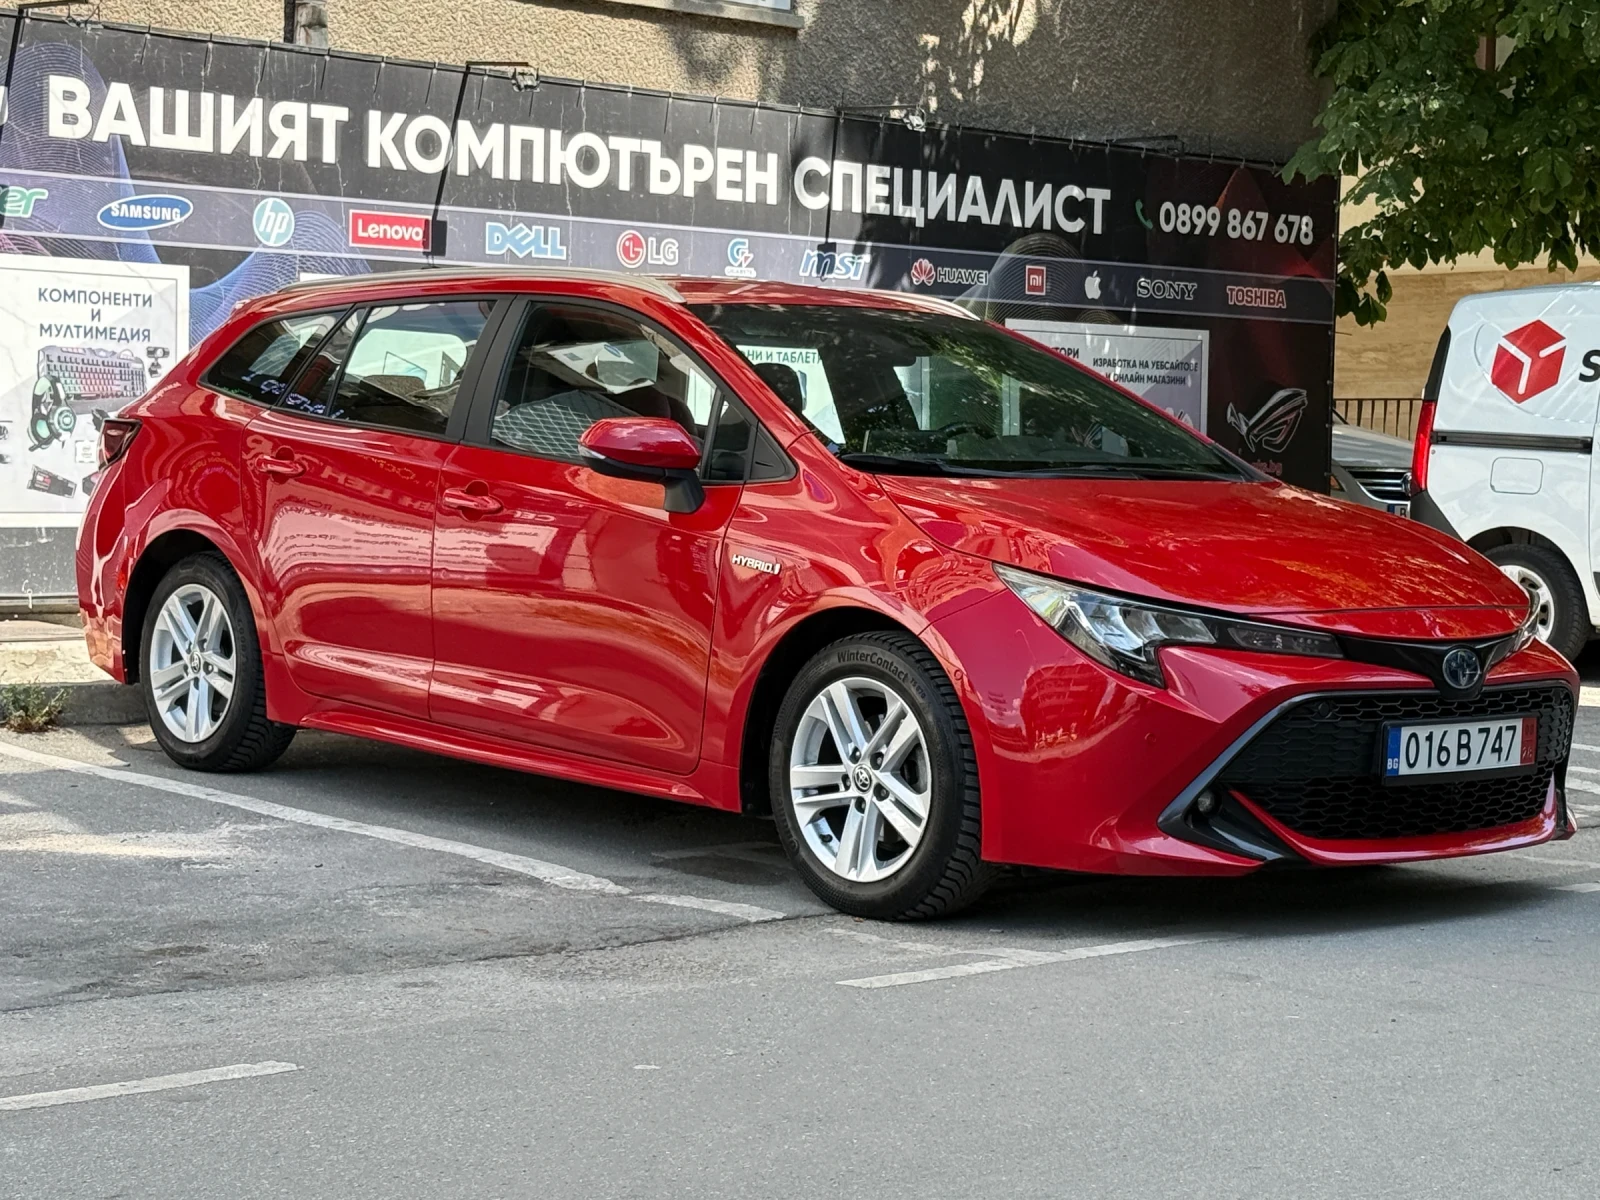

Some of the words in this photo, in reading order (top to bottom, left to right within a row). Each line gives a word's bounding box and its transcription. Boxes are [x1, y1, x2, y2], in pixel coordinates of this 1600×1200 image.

[48, 75, 349, 164] ВАШИЯТ
[368, 110, 778, 205] КОМПЮТЪРЕН
[794, 156, 1111, 235] СПЕЦИАЛИСТ
[110, 202, 181, 222] SAMSUNG
[261, 200, 287, 245] hp
[357, 219, 424, 241] Lenovo
[1159, 201, 1221, 236] 0899
[1227, 208, 1269, 241] 867
[1274, 214, 1313, 245] 678
[486, 222, 567, 260] DELL
[648, 237, 679, 265] LG
[800, 249, 867, 280] msi
[937, 267, 989, 286] HUAWEI
[38, 287, 152, 308] КОМПОНЕНТИ
[1136, 278, 1197, 300] SONY
[1226, 285, 1287, 308] TOSHIBA
[91, 308, 101, 323] И
[39, 323, 151, 343] МУЛТИМЕДИЯ
[741, 349, 763, 361] НИ
[776, 351, 821, 364] ТАБЛЕТ
[1093, 357, 1137, 369] ИЗРАБОТКА
[1139, 359, 1149, 369] НА
[1113, 371, 1145, 383] ОНЛАЙН
[1146, 374, 1186, 385] МАГАЗИНИ
[732, 554, 774, 573] HYBRID
[837, 651, 909, 683] WinterContact
[1387, 758, 1399, 770] BG
